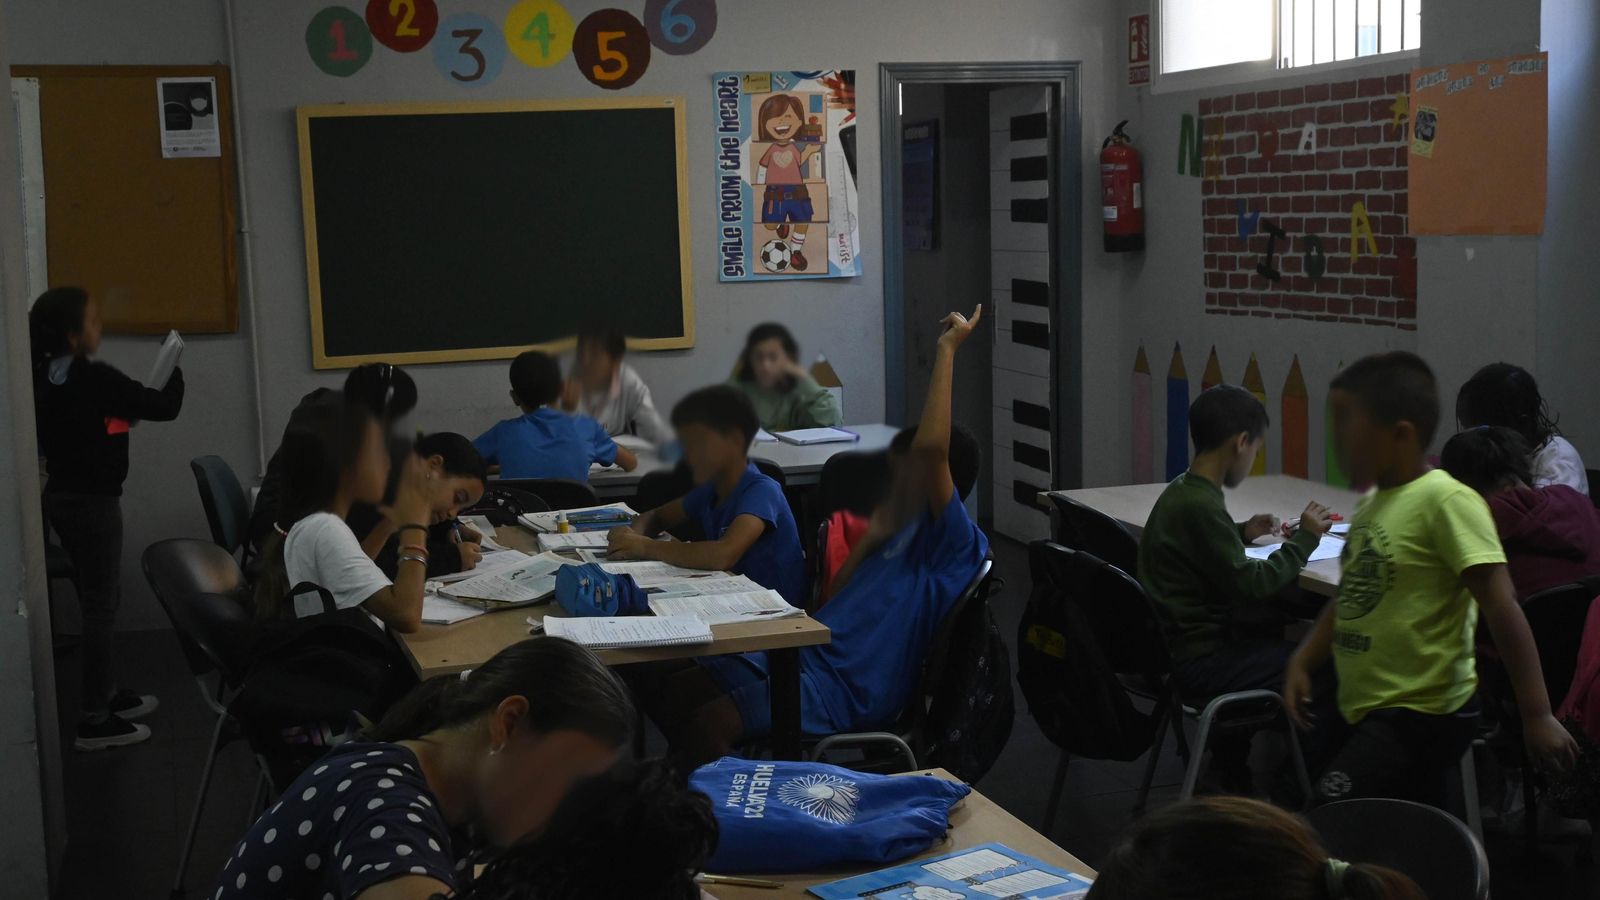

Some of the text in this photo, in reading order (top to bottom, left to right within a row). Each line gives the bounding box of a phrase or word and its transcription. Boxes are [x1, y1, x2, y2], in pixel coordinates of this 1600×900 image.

[327, 0, 696, 81] 1 2 3 4 5 6
[720, 137, 741, 171] the
[726, 773, 748, 808] ESPAÑA
